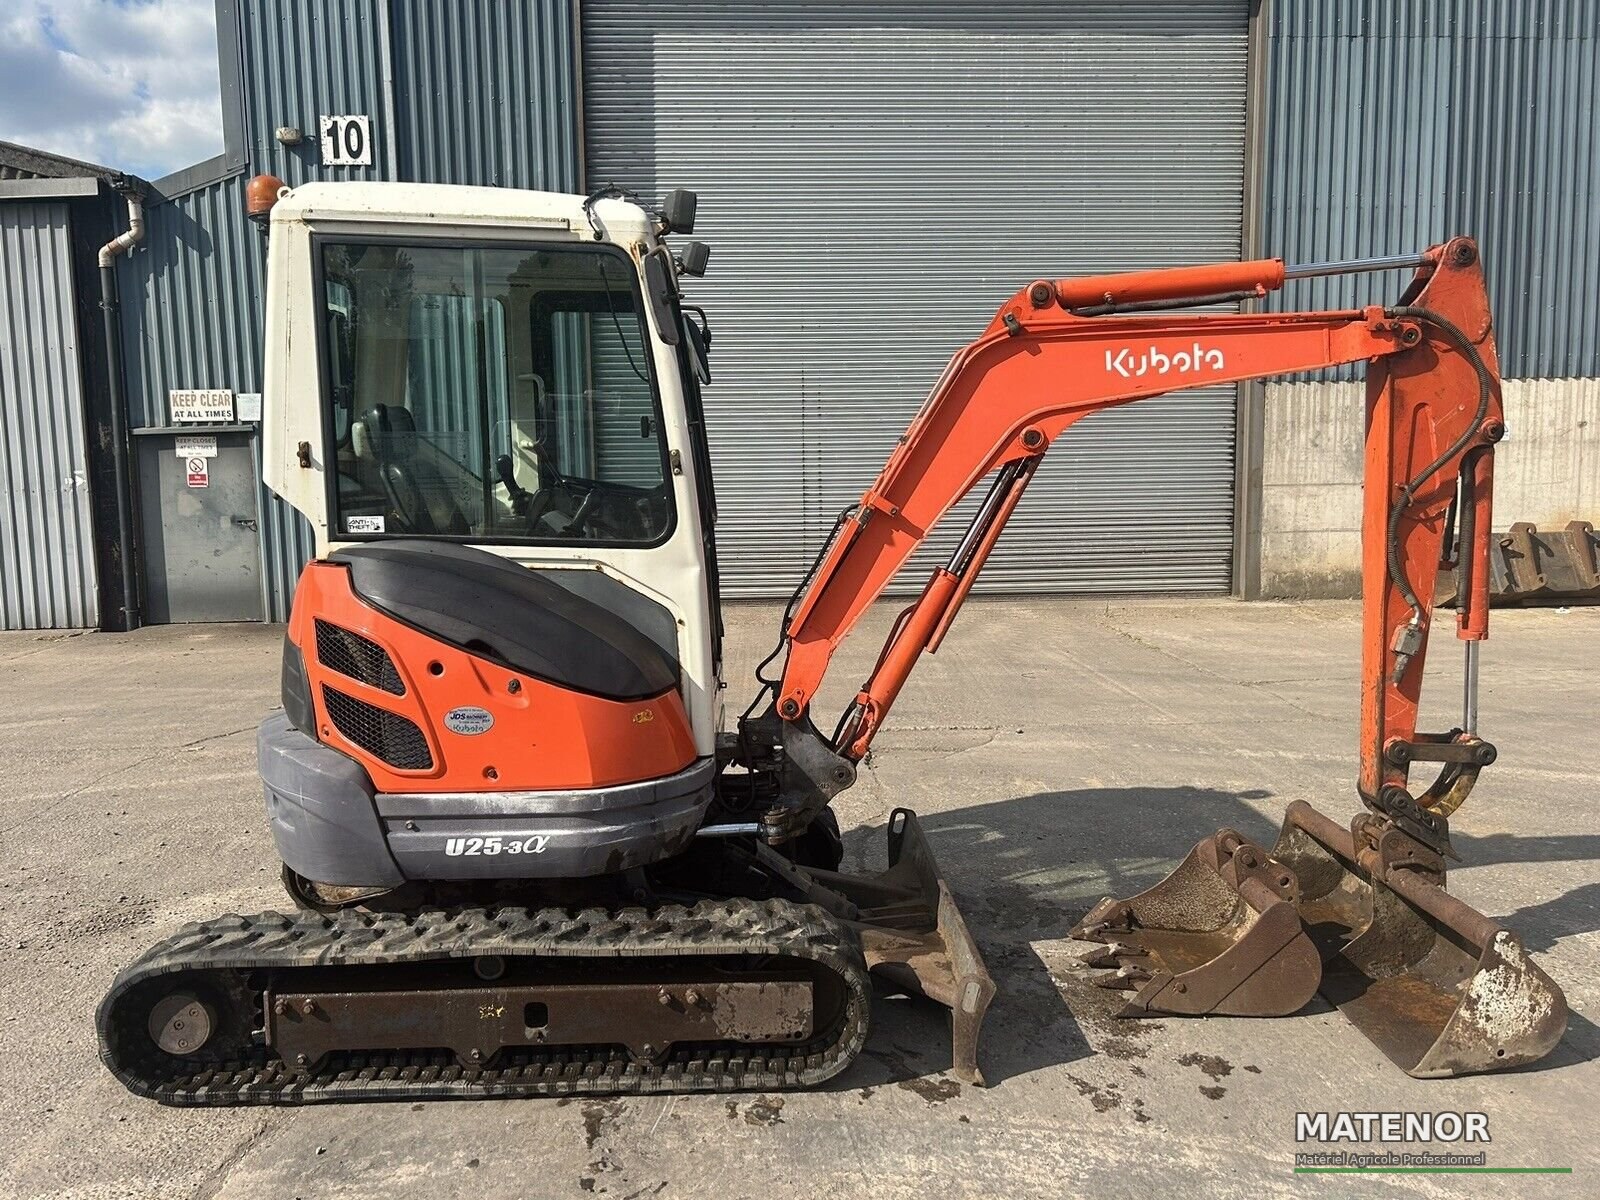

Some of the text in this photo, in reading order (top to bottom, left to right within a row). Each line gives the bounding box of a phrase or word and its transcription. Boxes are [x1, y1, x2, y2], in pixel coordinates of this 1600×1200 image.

[327, 120, 363, 159] 10
[1105, 343, 1224, 377] Kubota
[172, 394, 197, 407] KEEP
[200, 393, 231, 407] CLEAR
[205, 410, 232, 418] TIMES
[452, 724, 484, 732] Kubota
